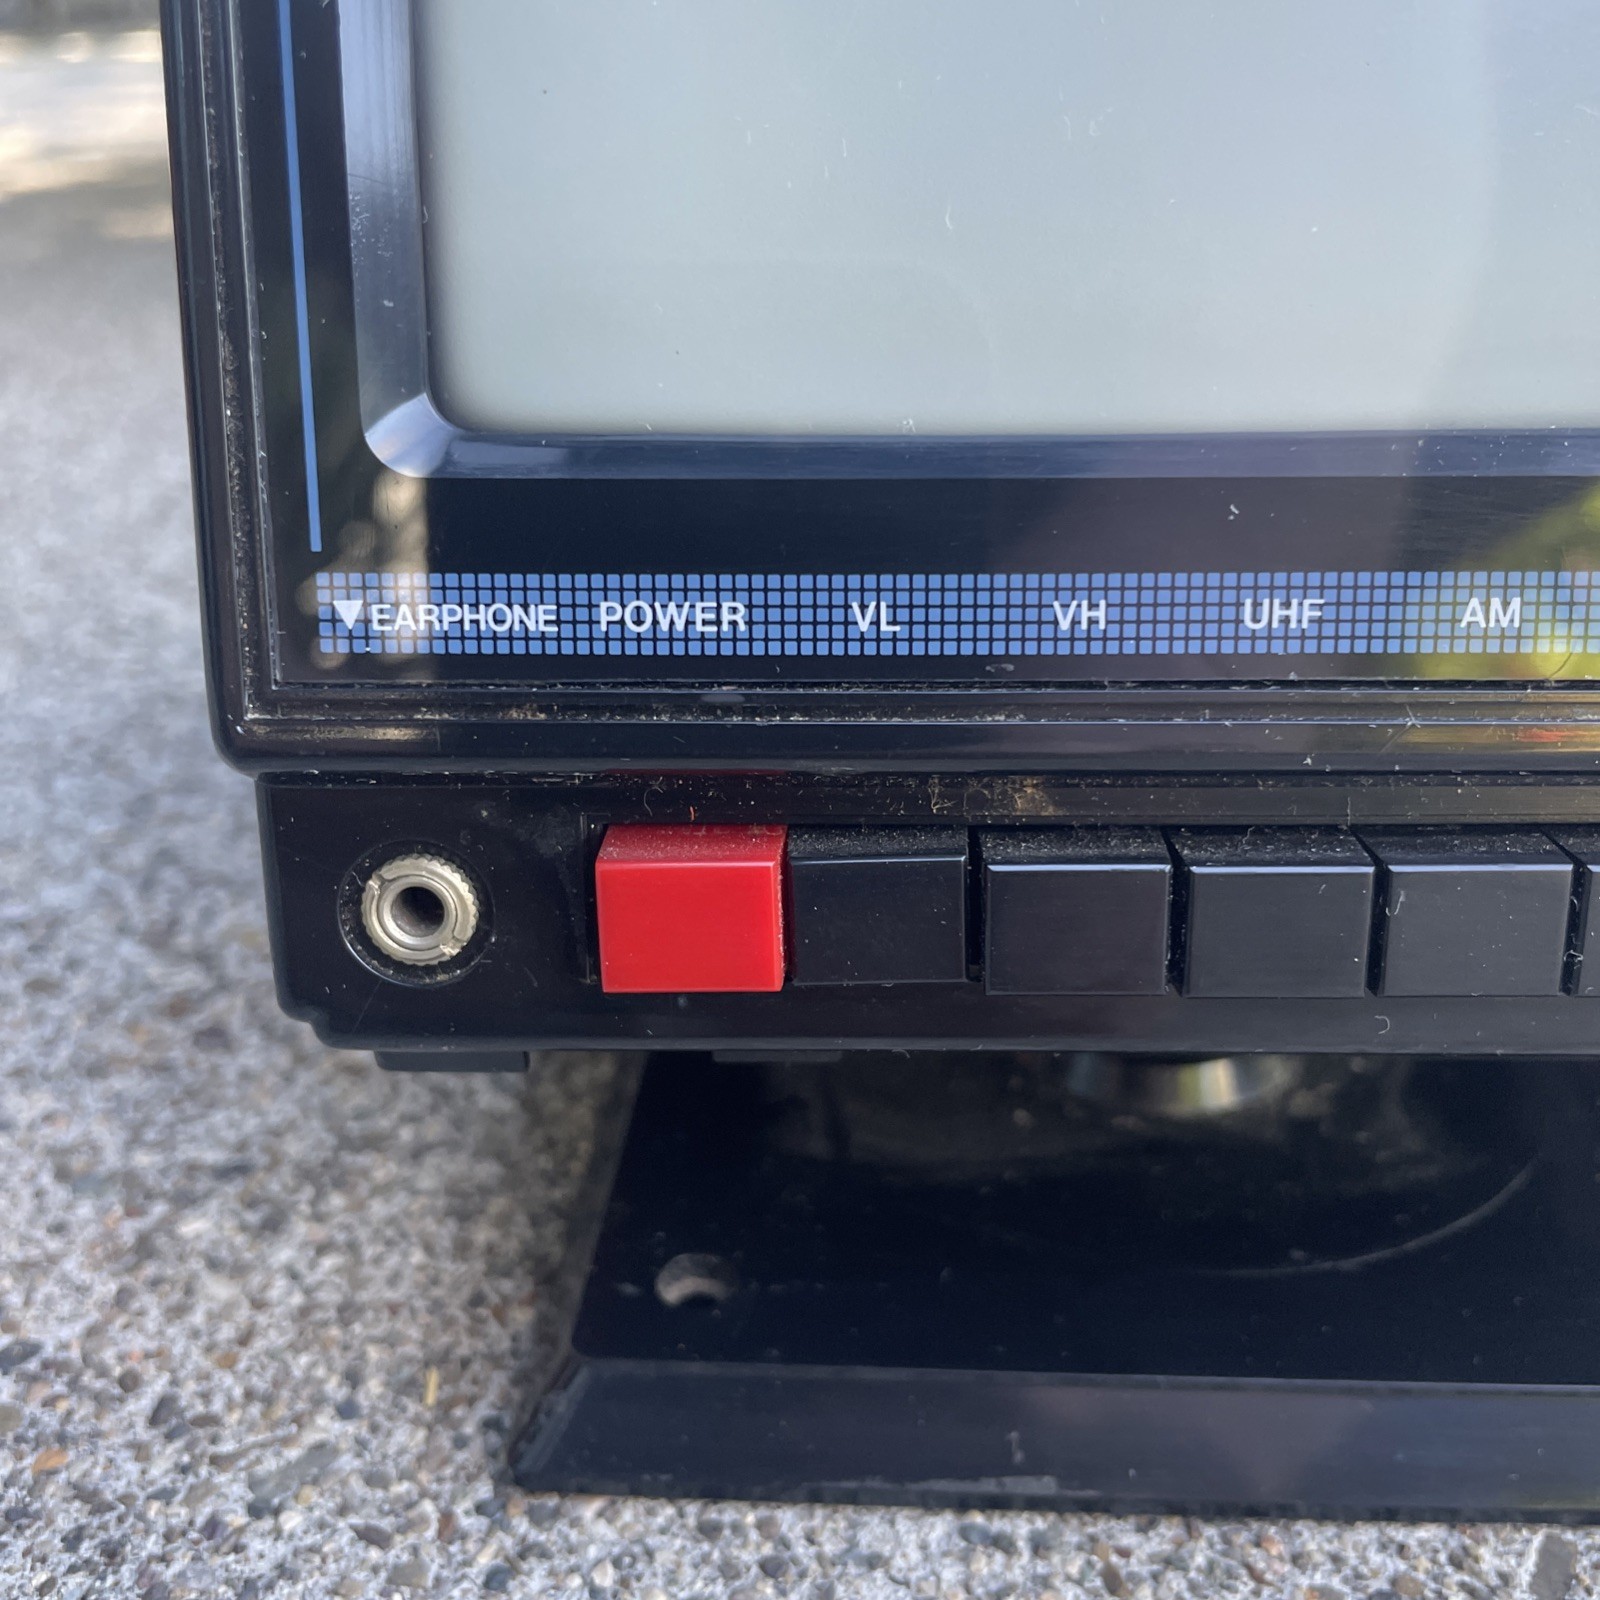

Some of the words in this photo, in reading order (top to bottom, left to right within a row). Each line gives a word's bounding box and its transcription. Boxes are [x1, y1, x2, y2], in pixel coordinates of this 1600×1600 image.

[370, 603, 559, 632] EARPHONE
[599, 600, 746, 632] POWER
[851, 601, 901, 632] VL
[1052, 599, 1106, 631] VH
[1243, 598, 1326, 630] UHF
[1459, 596, 1522, 629] AM
